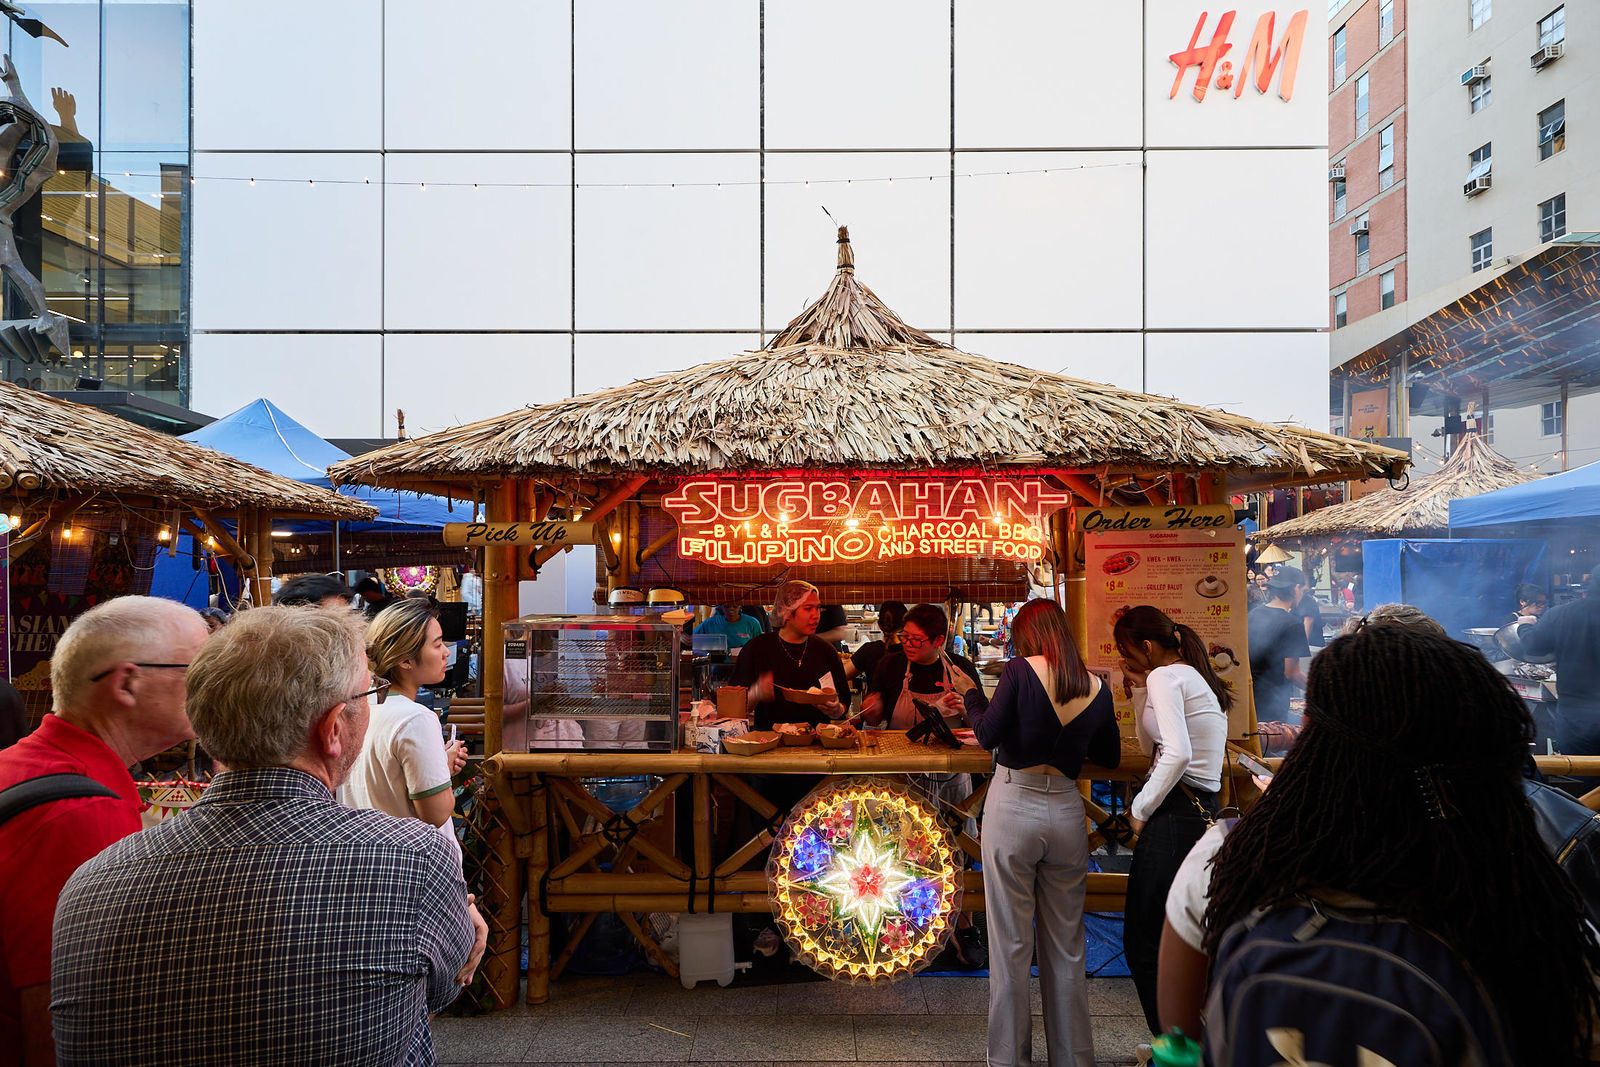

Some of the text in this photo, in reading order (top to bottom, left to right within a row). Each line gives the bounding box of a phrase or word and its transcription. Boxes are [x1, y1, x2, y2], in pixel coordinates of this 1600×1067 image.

[1169, 10, 1309, 103] H&M
[665, 480, 1069, 523] SUGBAHAN
[1082, 507, 1226, 530] Order Here
[465, 522, 568, 545] Pick Up
[877, 522, 1042, 543] CHARCOAL BBQ
[681, 529, 874, 564] FILIPINO
[878, 538, 1042, 560] AND STREET FOOD
